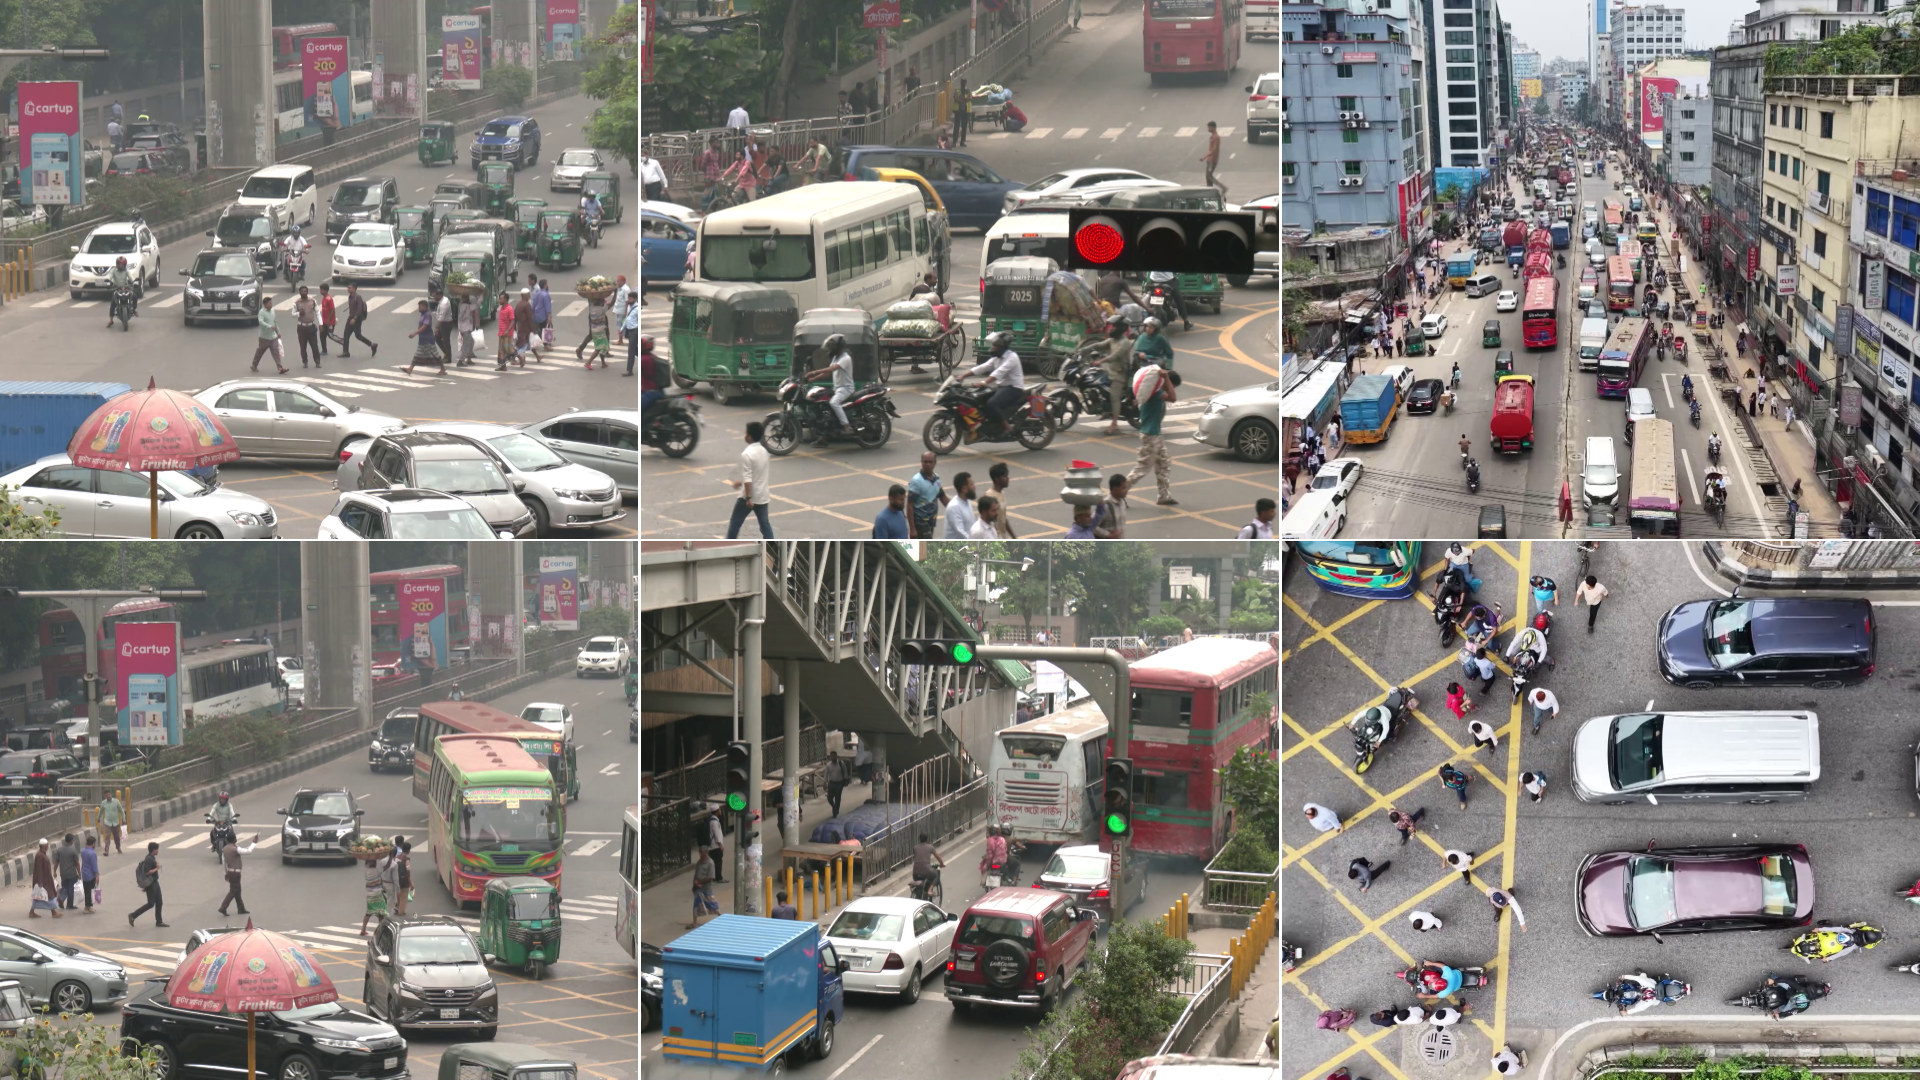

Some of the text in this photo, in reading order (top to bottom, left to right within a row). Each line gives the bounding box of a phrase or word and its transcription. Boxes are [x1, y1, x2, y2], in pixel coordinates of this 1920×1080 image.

[453, 19, 476, 27] cartup
[315, 43, 343, 52] cartup
[36, 103, 73, 115] cartup
[1010, 290, 1032, 302] 2025
[140, 457, 187, 470] Frutika
[550, 560, 573, 568] cartup
[412, 584, 440, 593] cartup
[133, 644, 170, 656] cartup
[1024, 805, 1039, 815] অটো
[1111, 843, 1120, 872] UCC
[238, 999, 284, 1011] Frutika
